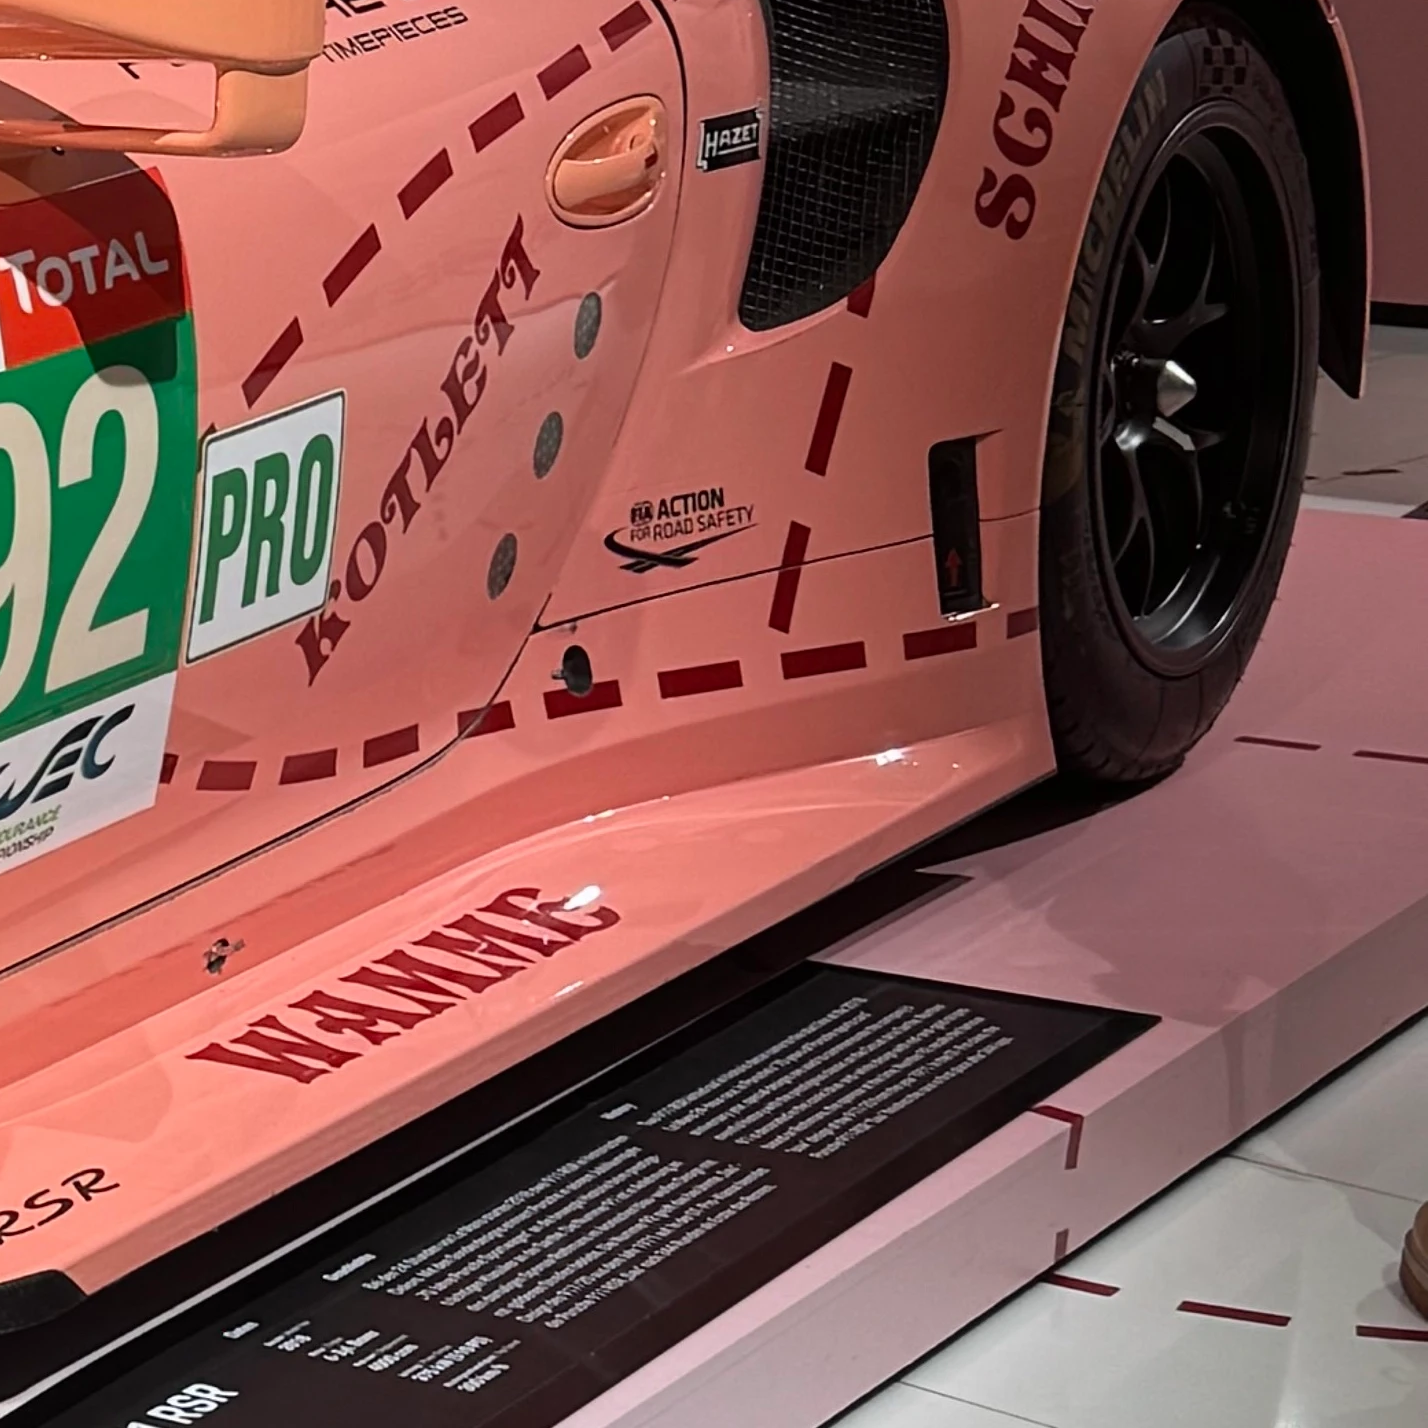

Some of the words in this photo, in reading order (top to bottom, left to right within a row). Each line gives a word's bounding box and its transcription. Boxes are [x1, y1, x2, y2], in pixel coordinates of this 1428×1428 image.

[321, 5, 469, 64] TIMEPIECES
[704, 122, 758, 158] HAZET
[294, 212, 541, 688] KOTLETT
[630, 525, 651, 542] FOR
[652, 517, 694, 541] ROAD
[696, 503, 754, 533] SAFETY
[657, 486, 725, 521] ACTION
[197, 433, 335, 626] PRO
[184, 886, 622, 1085] WAMME
[147, 1381, 239, 1425] RSR
